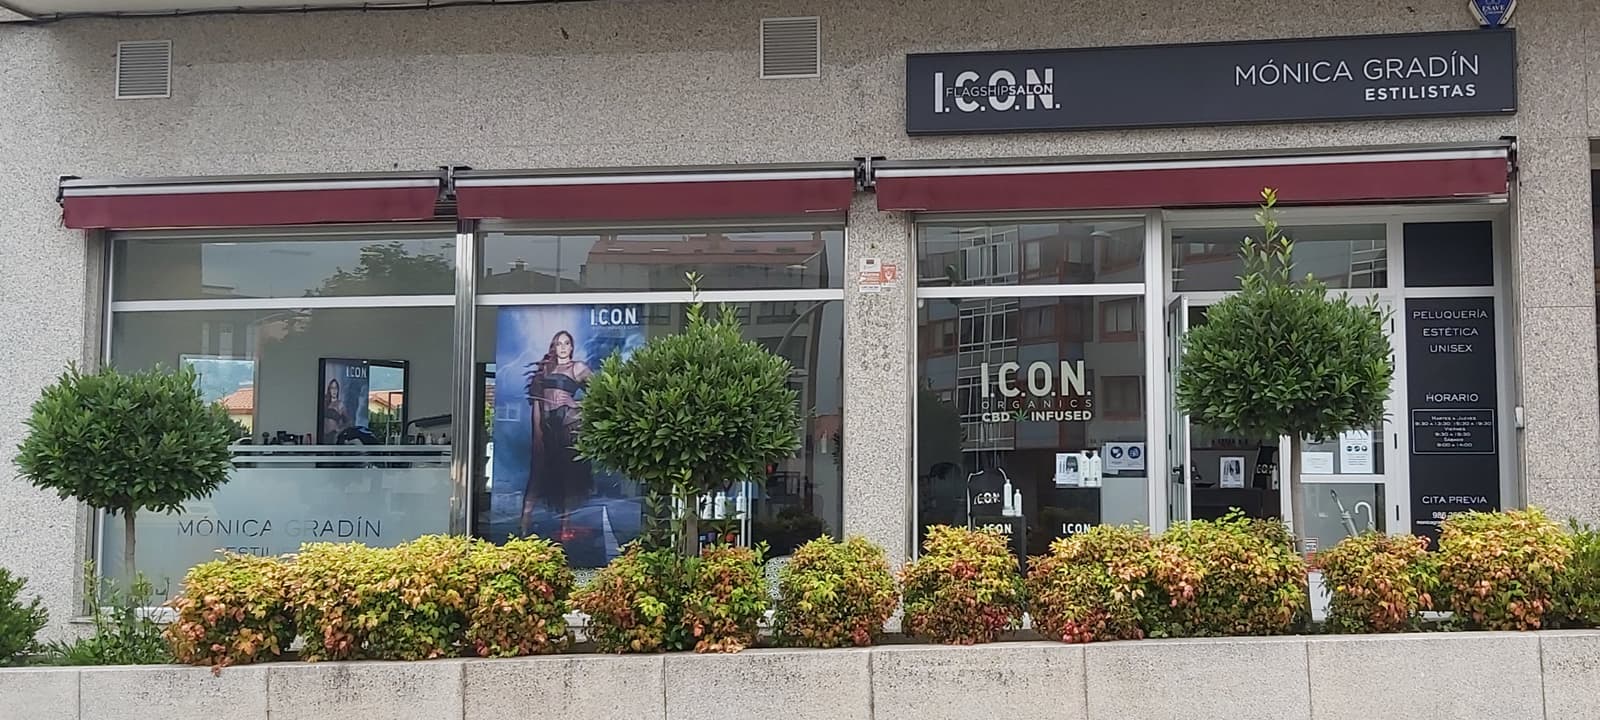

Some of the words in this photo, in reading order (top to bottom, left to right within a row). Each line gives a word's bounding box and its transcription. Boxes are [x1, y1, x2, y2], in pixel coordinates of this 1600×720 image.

[1235, 59, 1354, 86] MÓNICA
[1363, 50, 1480, 80] GRADÍN
[1365, 83, 1476, 101] ESTILISTAS
[1413, 309, 1488, 319] PELUQUERÍA
[1423, 327, 1479, 337] ESTÉTICA
[1430, 344, 1473, 353] UNISEX
[981, 360, 1092, 398] I.C.O.N.
[1426, 393, 1479, 402] HORARIO
[981, 399, 1092, 410] ORGANICS
[982, 411, 1010, 422] CBD
[1031, 410, 1092, 421] INFUSED
[1422, 496, 1447, 504] CITA
[1448, 496, 1488, 504] PREVIA
[1432, 511, 1447, 519] 986
[177, 516, 272, 537] MÓNICA
[286, 516, 381, 538] GRADÍN
